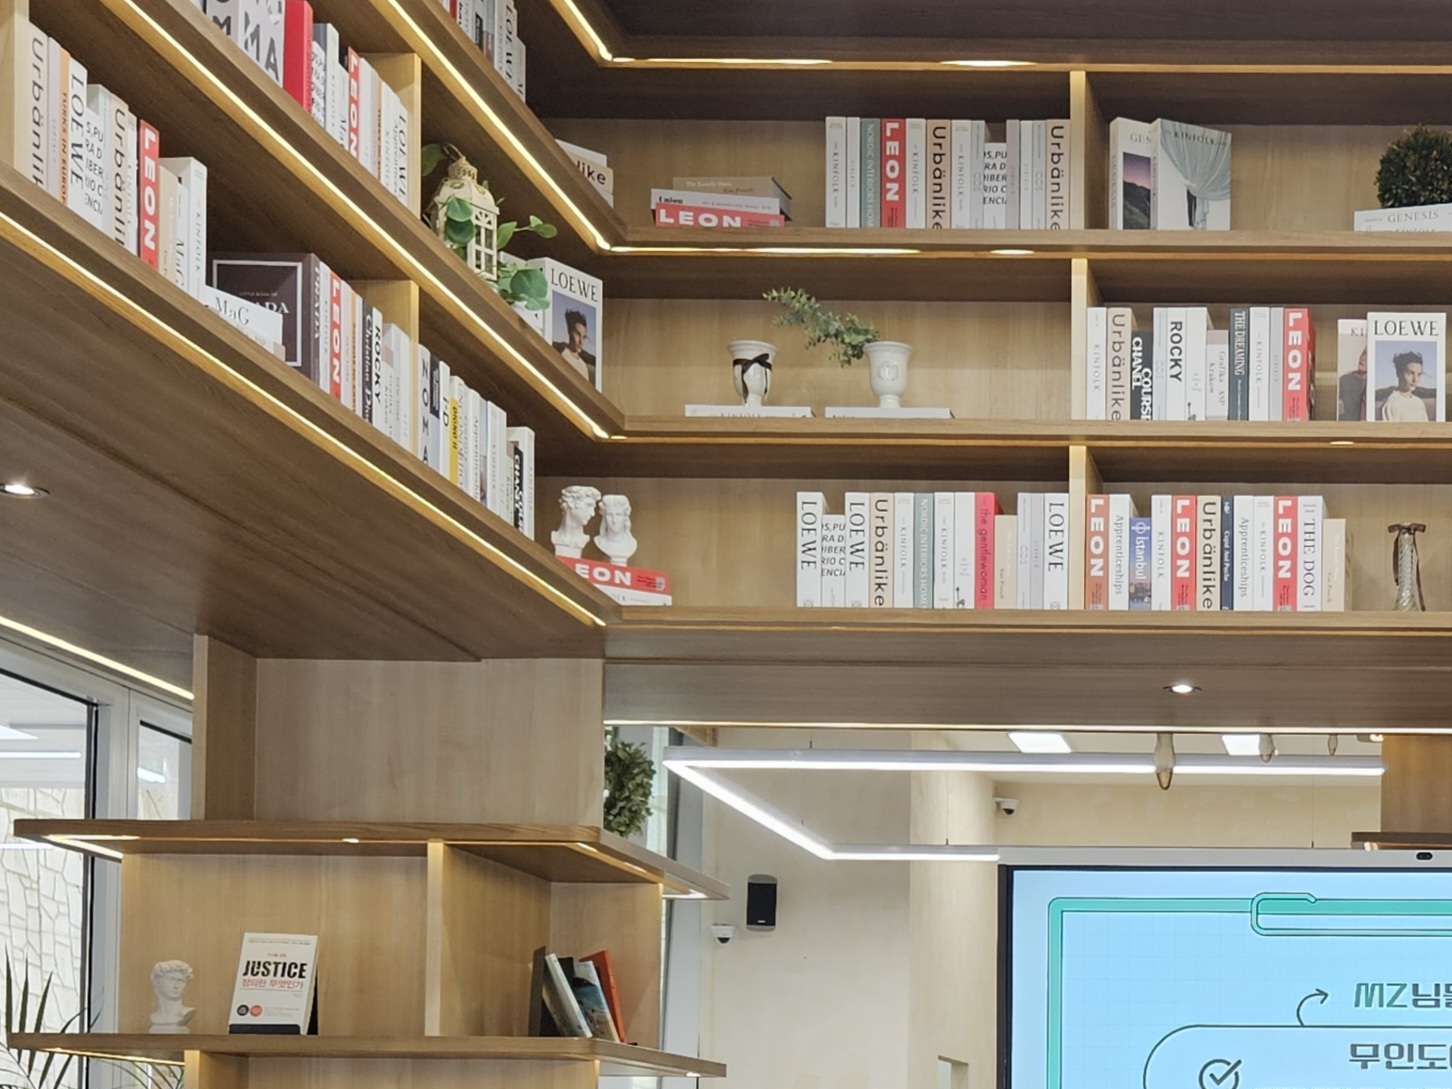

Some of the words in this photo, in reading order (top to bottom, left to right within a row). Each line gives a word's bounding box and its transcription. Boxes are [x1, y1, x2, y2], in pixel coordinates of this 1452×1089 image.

[71, 74, 84, 190] LOEWE
[886, 122, 899, 201] LEON
[144, 128, 156, 251] LEON
[659, 209, 741, 227] LEON
[1387, 210, 1440, 224] GENESIS
[215, 297, 250, 325] MaG
[551, 268, 598, 303] LOEWE
[1235, 311, 1246, 329] THE
[332, 278, 340, 384] LEON
[1170, 321, 1183, 382] ROCKY
[1235, 331, 1246, 376] DREAMING
[1288, 312, 1303, 391] LEON
[1373, 320, 1439, 337] LOEWE
[373, 325, 382, 404] ROCKY
[1112, 314, 1126, 420] Urbänlike
[1132, 337, 1143, 390] CHANEL
[801, 501, 817, 570] LOEWE
[850, 502, 865, 571] LOEWE
[875, 500, 888, 606] Urbänlike
[1049, 502, 1065, 572] LOEWE
[1090, 499, 1104, 577] LEON
[1115, 514, 1124, 596] Apprenticeships
[1135, 536, 1146, 581] istanbul
[1176, 499, 1190, 579] LEON
[1202, 502, 1217, 610] Urbänlike
[1240, 516, 1249, 598] Apprenticeships
[1278, 499, 1292, 579] LEON
[1304, 518, 1316, 553] THE
[1304, 558, 1316, 597] DOG
[242, 960, 308, 979] JUSTICE
